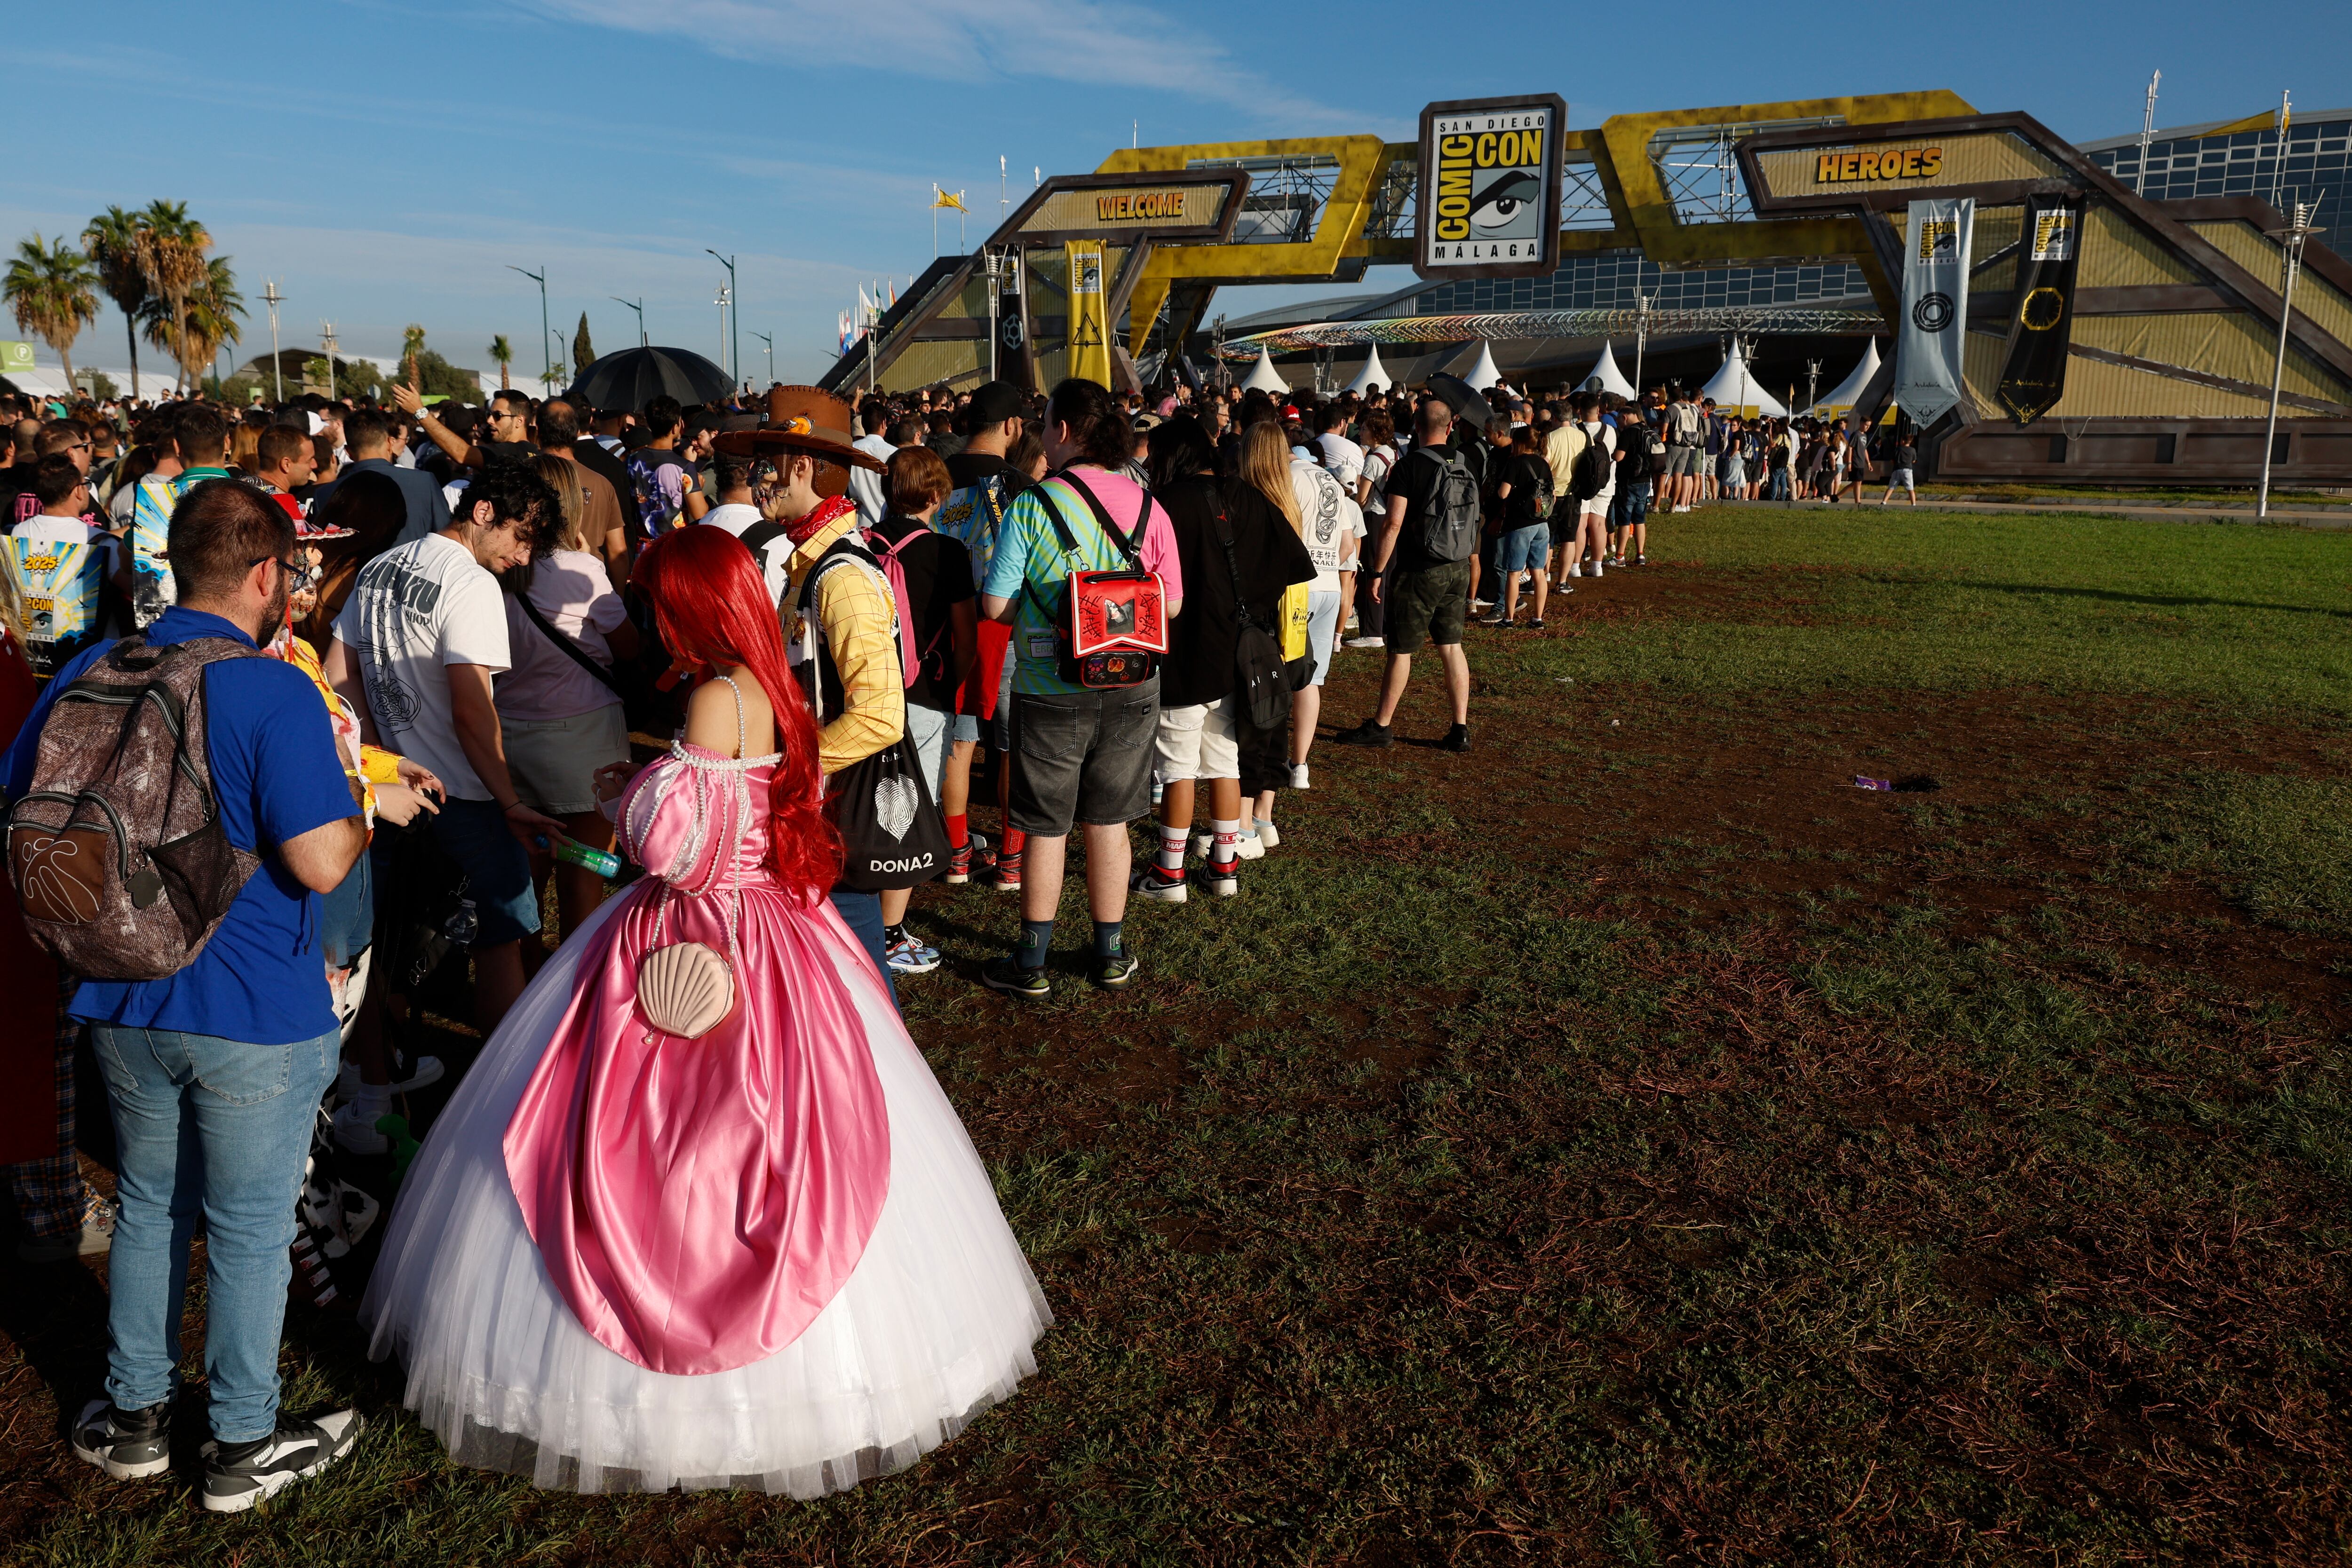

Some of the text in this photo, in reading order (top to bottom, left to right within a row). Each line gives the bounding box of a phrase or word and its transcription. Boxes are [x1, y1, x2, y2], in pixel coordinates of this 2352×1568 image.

[1439, 115, 1545, 133] SAN DIEGO
[1476, 129, 1542, 168] CON
[1817, 147, 1943, 183] HEROES
[1437, 135, 1474, 240] COMIC
[1098, 192, 1184, 220] WELCOME
[2051, 216, 2073, 228] CON
[1921, 223, 1934, 257] COMIC
[2036, 216, 2053, 253] COMIC
[1434, 243, 1535, 259] MÁLAGA
[1075, 259, 1084, 287] COMIC
[1084, 259, 1099, 268] CON
[942, 503, 972, 525] 2025
[24, 556, 57, 570] 2025
[32, 598, 54, 611] CON
[405, 610, 430, 626] SHOP
[1252, 671, 1278, 688] AIR
[870, 852, 934, 873] DONA2
[253, 1443, 275, 1466] PUMA
